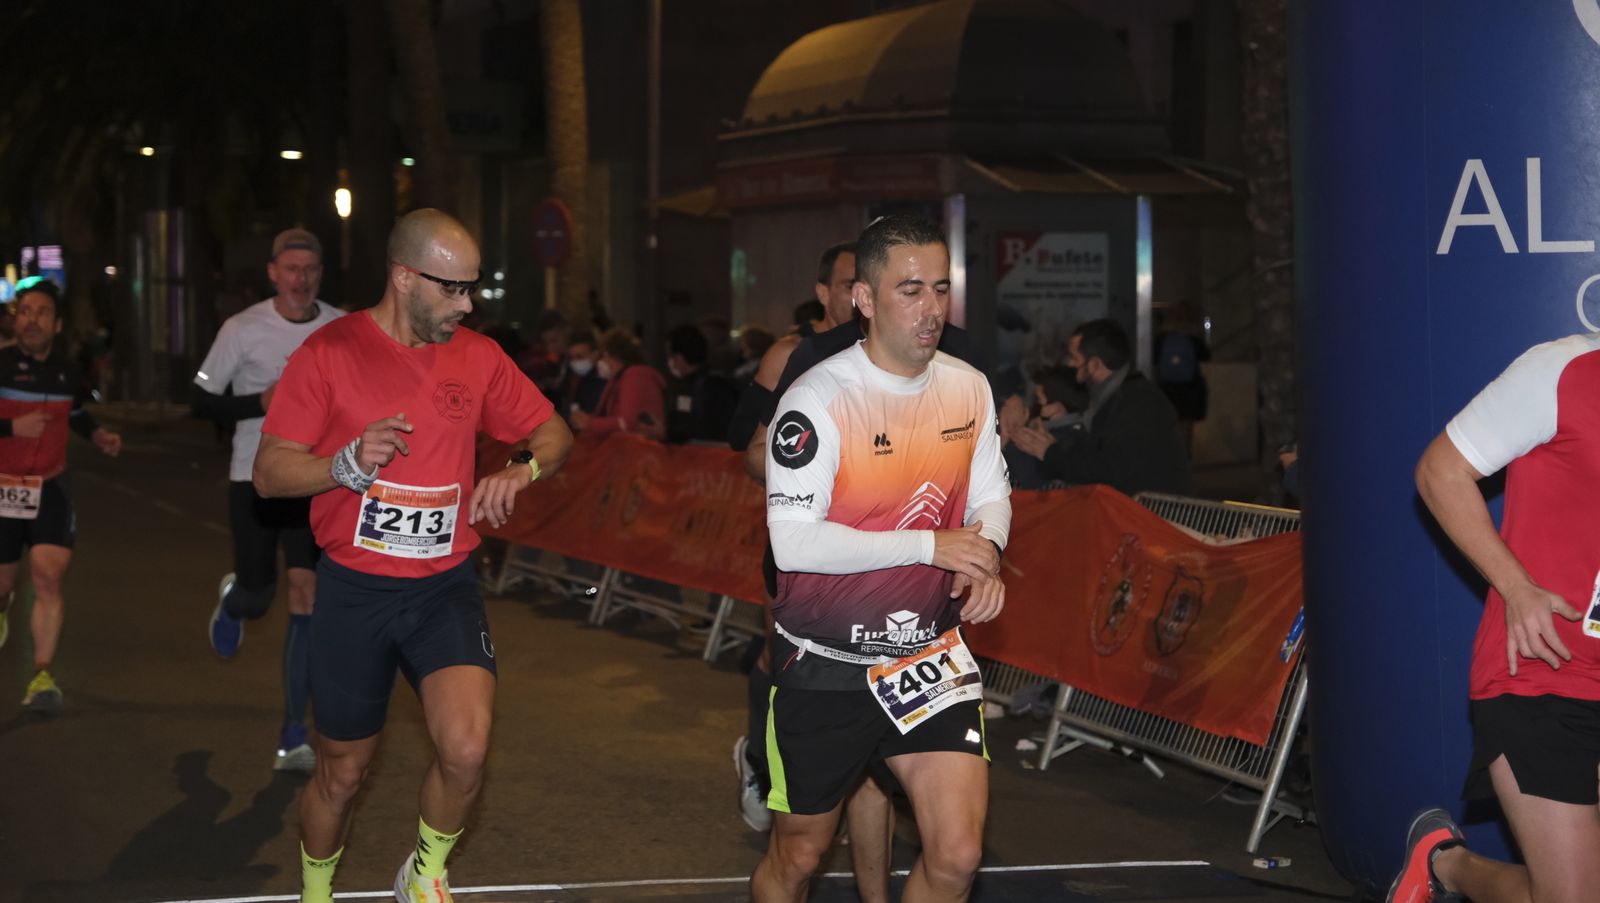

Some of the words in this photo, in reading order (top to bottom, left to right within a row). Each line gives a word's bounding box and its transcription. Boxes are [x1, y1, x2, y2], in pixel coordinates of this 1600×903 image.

[379, 507, 445, 535] 213
[851, 620, 938, 646] Europack
[898, 652, 961, 696] 401
